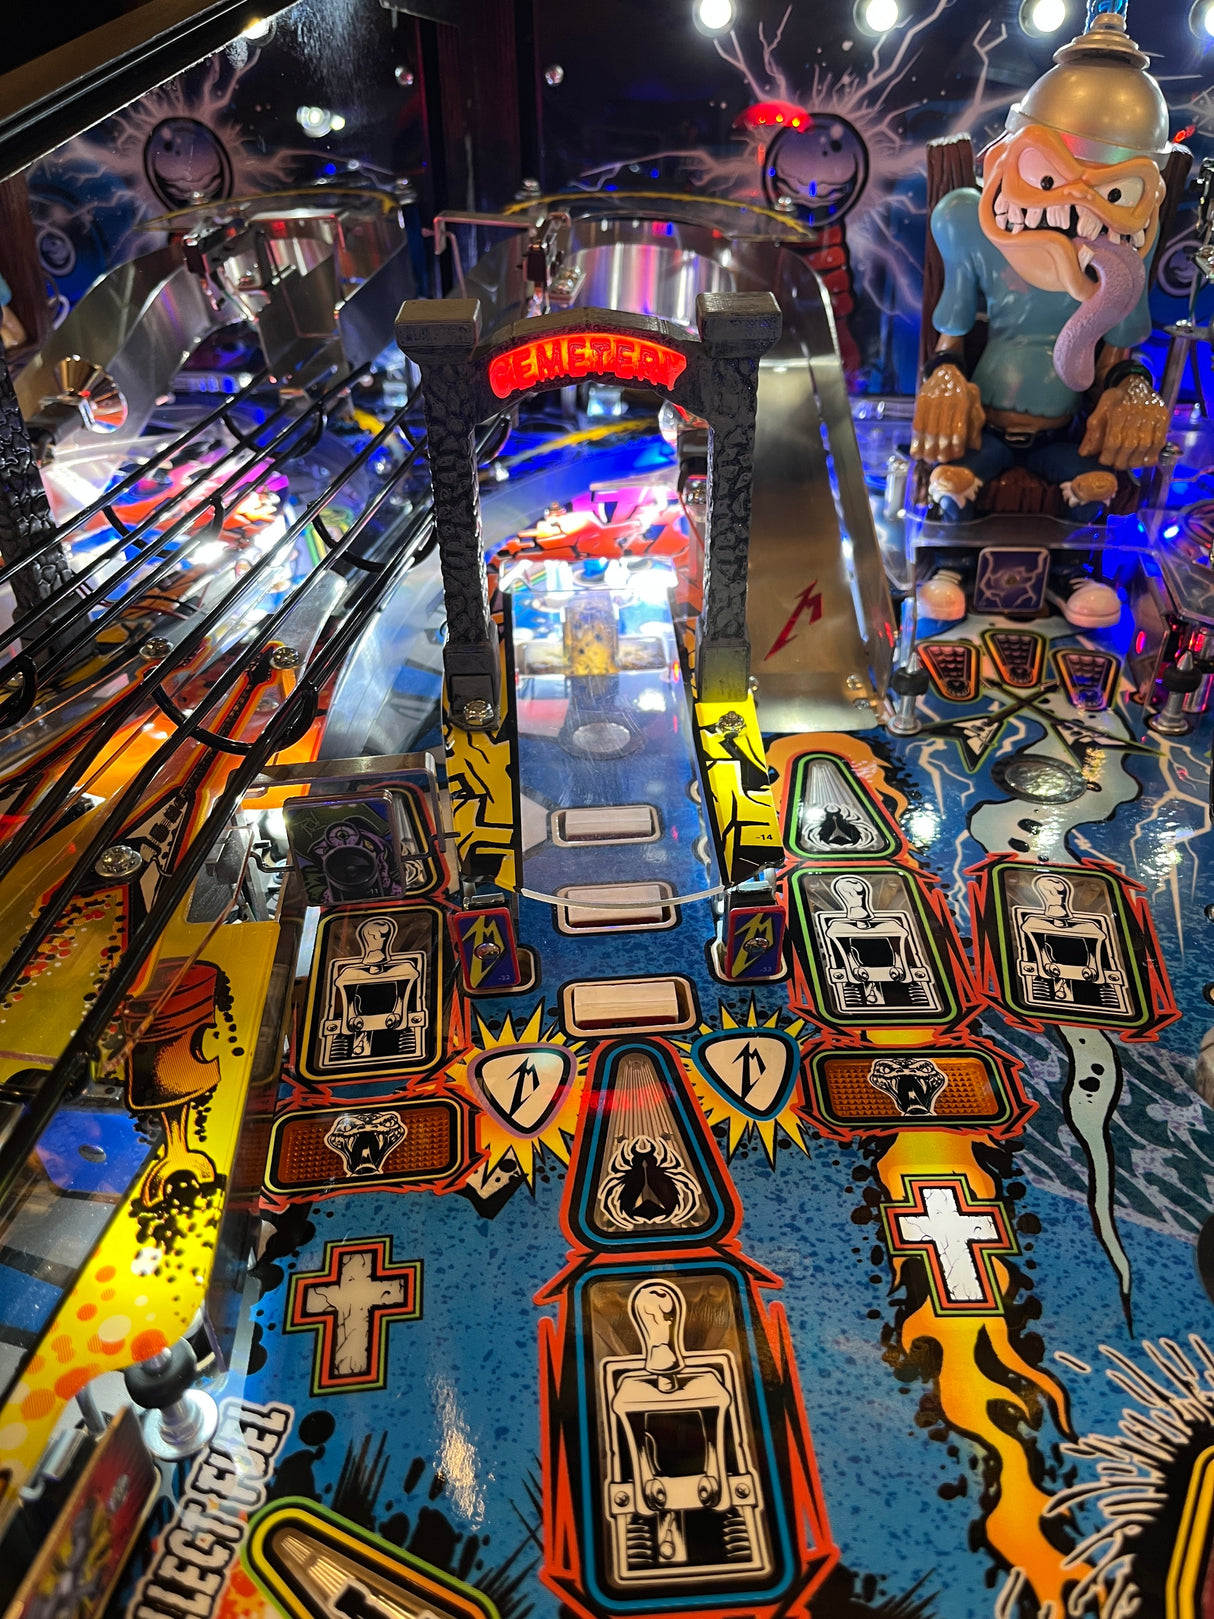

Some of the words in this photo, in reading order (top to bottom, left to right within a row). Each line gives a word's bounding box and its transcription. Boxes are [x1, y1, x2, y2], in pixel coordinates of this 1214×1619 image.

[489, 333, 687, 398] CEMETERY
[756, 833, 774, 842] -14
[191, 1403, 291, 1506] FUEL
